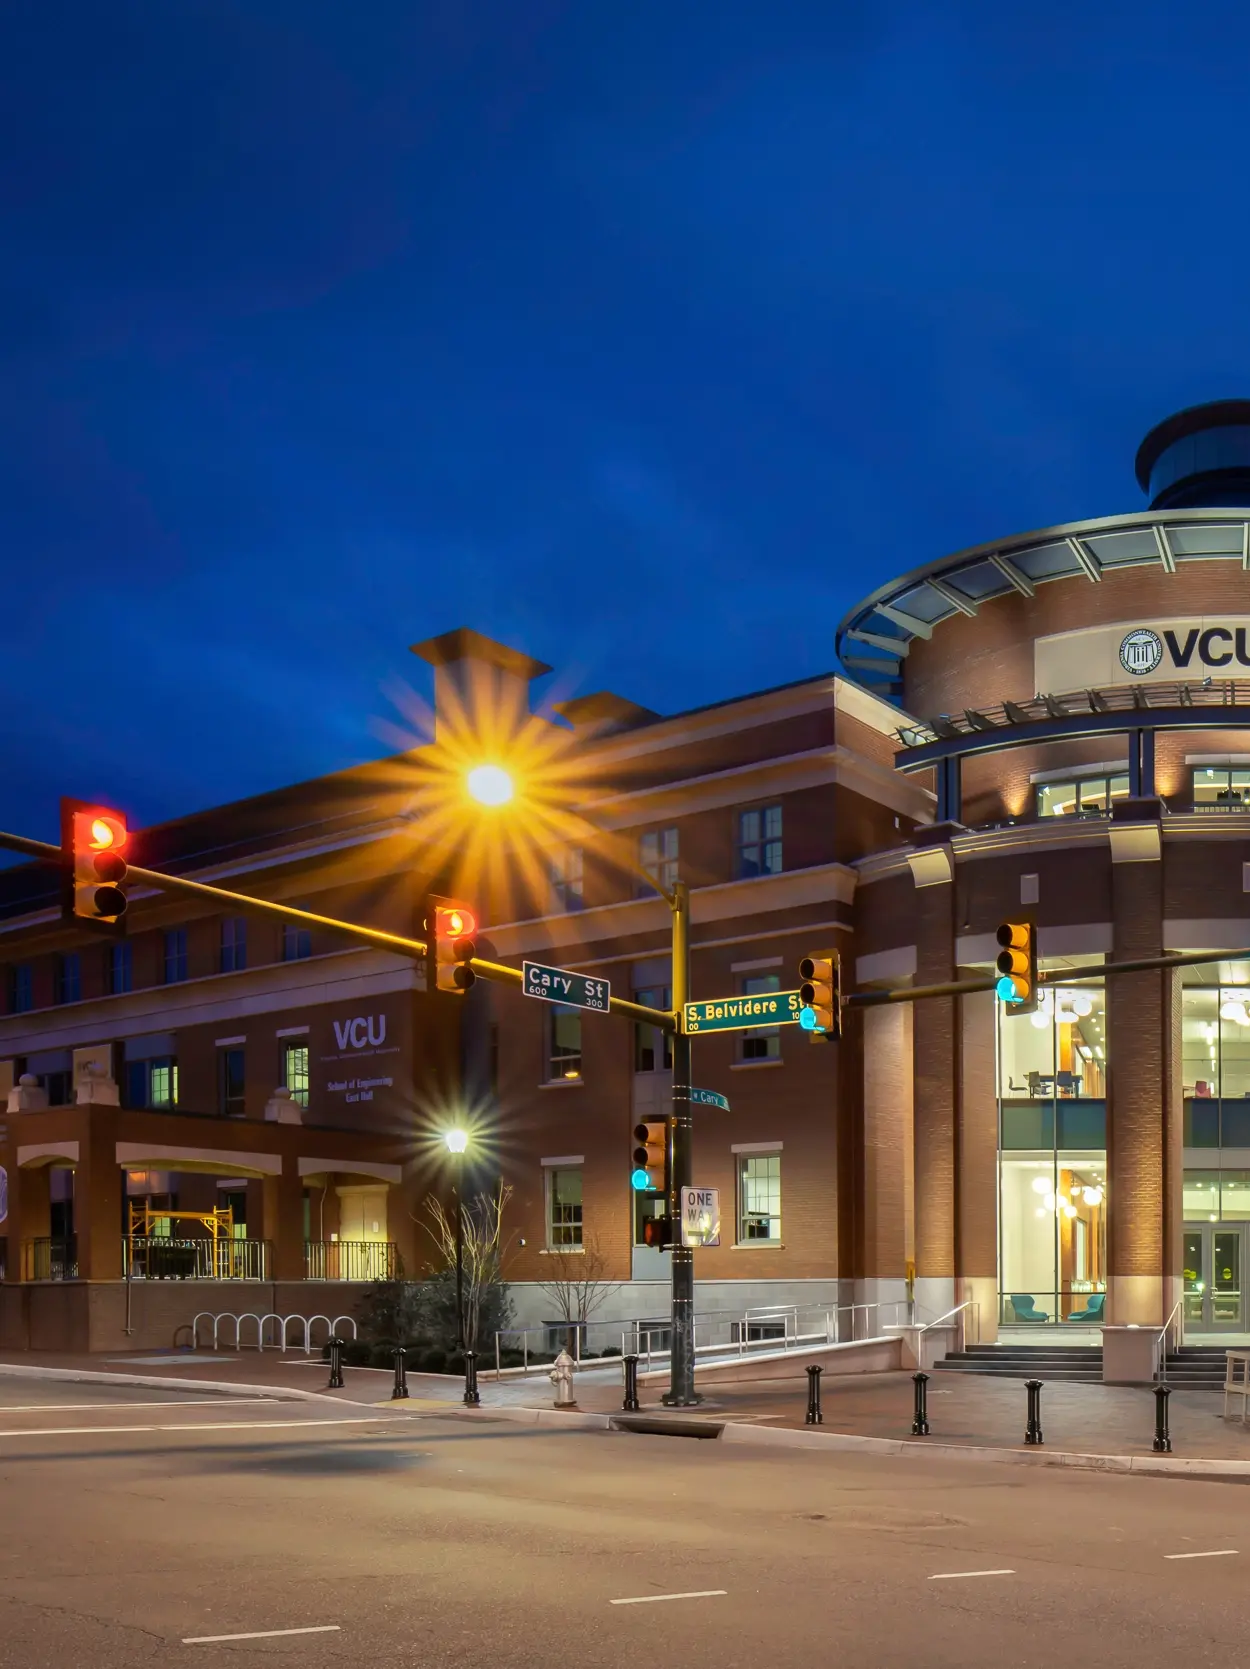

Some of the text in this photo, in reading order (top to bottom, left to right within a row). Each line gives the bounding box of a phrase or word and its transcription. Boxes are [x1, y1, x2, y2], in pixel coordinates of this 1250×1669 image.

[529, 968, 603, 998] Cary St
[529, 986, 602, 1008] 600 300
[688, 1006, 701, 1021] S.
[705, 1000, 777, 1020] Belvidere
[333, 1014, 386, 1050] VCU
[689, 1023, 698, 1031] 00
[700, 1092, 718, 1104] Cary
[688, 1192, 712, 1206] ONE
